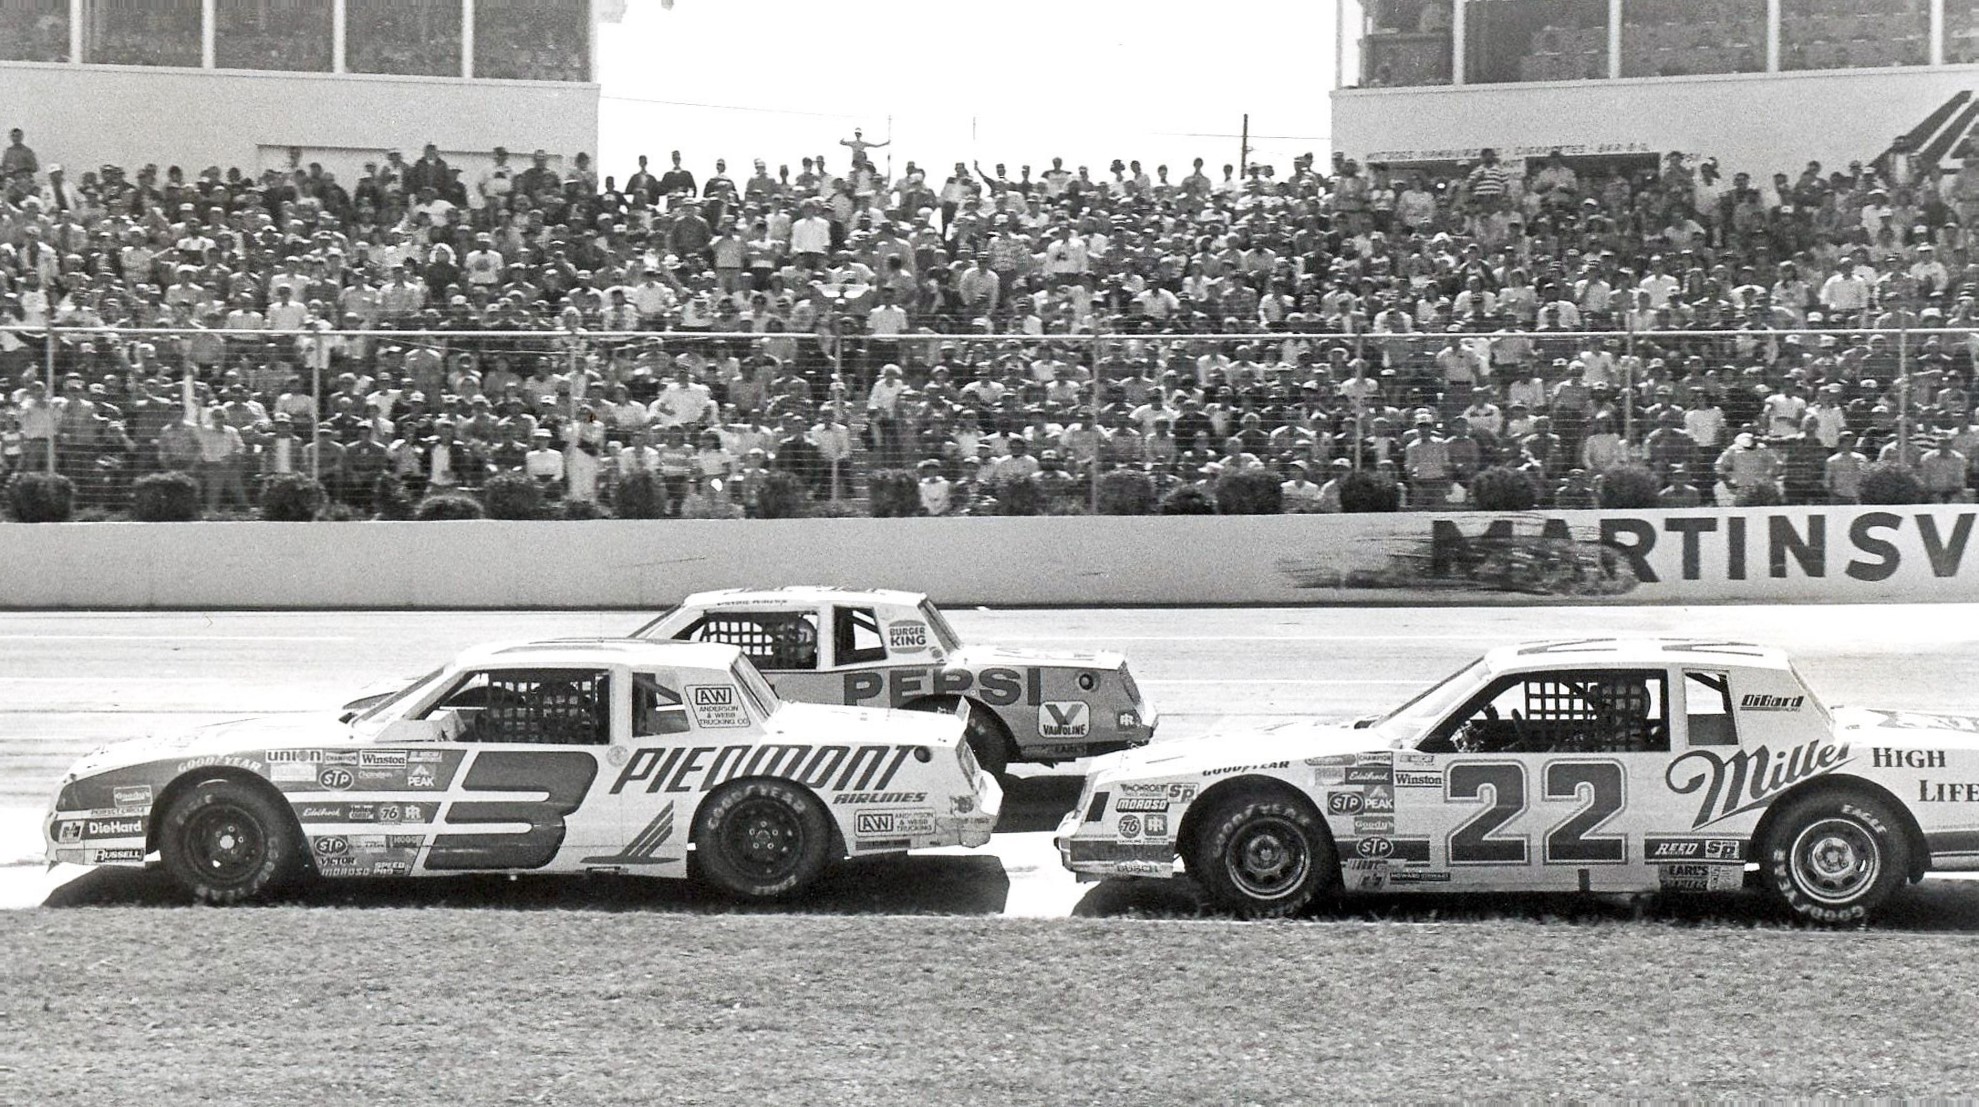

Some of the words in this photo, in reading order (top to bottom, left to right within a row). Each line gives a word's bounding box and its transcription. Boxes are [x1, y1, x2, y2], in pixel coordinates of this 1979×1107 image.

[889, 626, 926, 636] BURGER
[890, 635, 927, 647] KING
[843, 667, 1041, 708] PEPSI
[177, 754, 263, 773] GOODYEAR
[361, 753, 406, 764] Winston
[1359, 754, 1391, 762] CHAMPION
[1872, 747, 1947, 769] HIGH
[609, 744, 917, 794] PIEDMONT
[322, 768, 350, 787] STP
[407, 776, 435, 787] PEAK
[1395, 773, 1443, 785] Winston
[1665, 739, 1850, 829] Miller
[1918, 779, 1979, 803] LIFE
[832, 792, 928, 804] AIRLINES
[1116, 799, 1167, 810] MOROSO
[1332, 794, 1358, 811] STP
[1364, 799, 1394, 809] PEAK
[382, 807, 398, 819] 76
[1444, 757, 1628, 867] 22
[89, 821, 143, 834] DieHard
[1121, 819, 1138, 833] 76
[1354, 820, 1395, 831] Goody's
[319, 838, 343, 852] STP
[1361, 837, 1389, 854] STP
[1655, 842, 1699, 856] REED
[95, 849, 143, 862] RUSSELL
[1668, 865, 1709, 876] EARL'S
